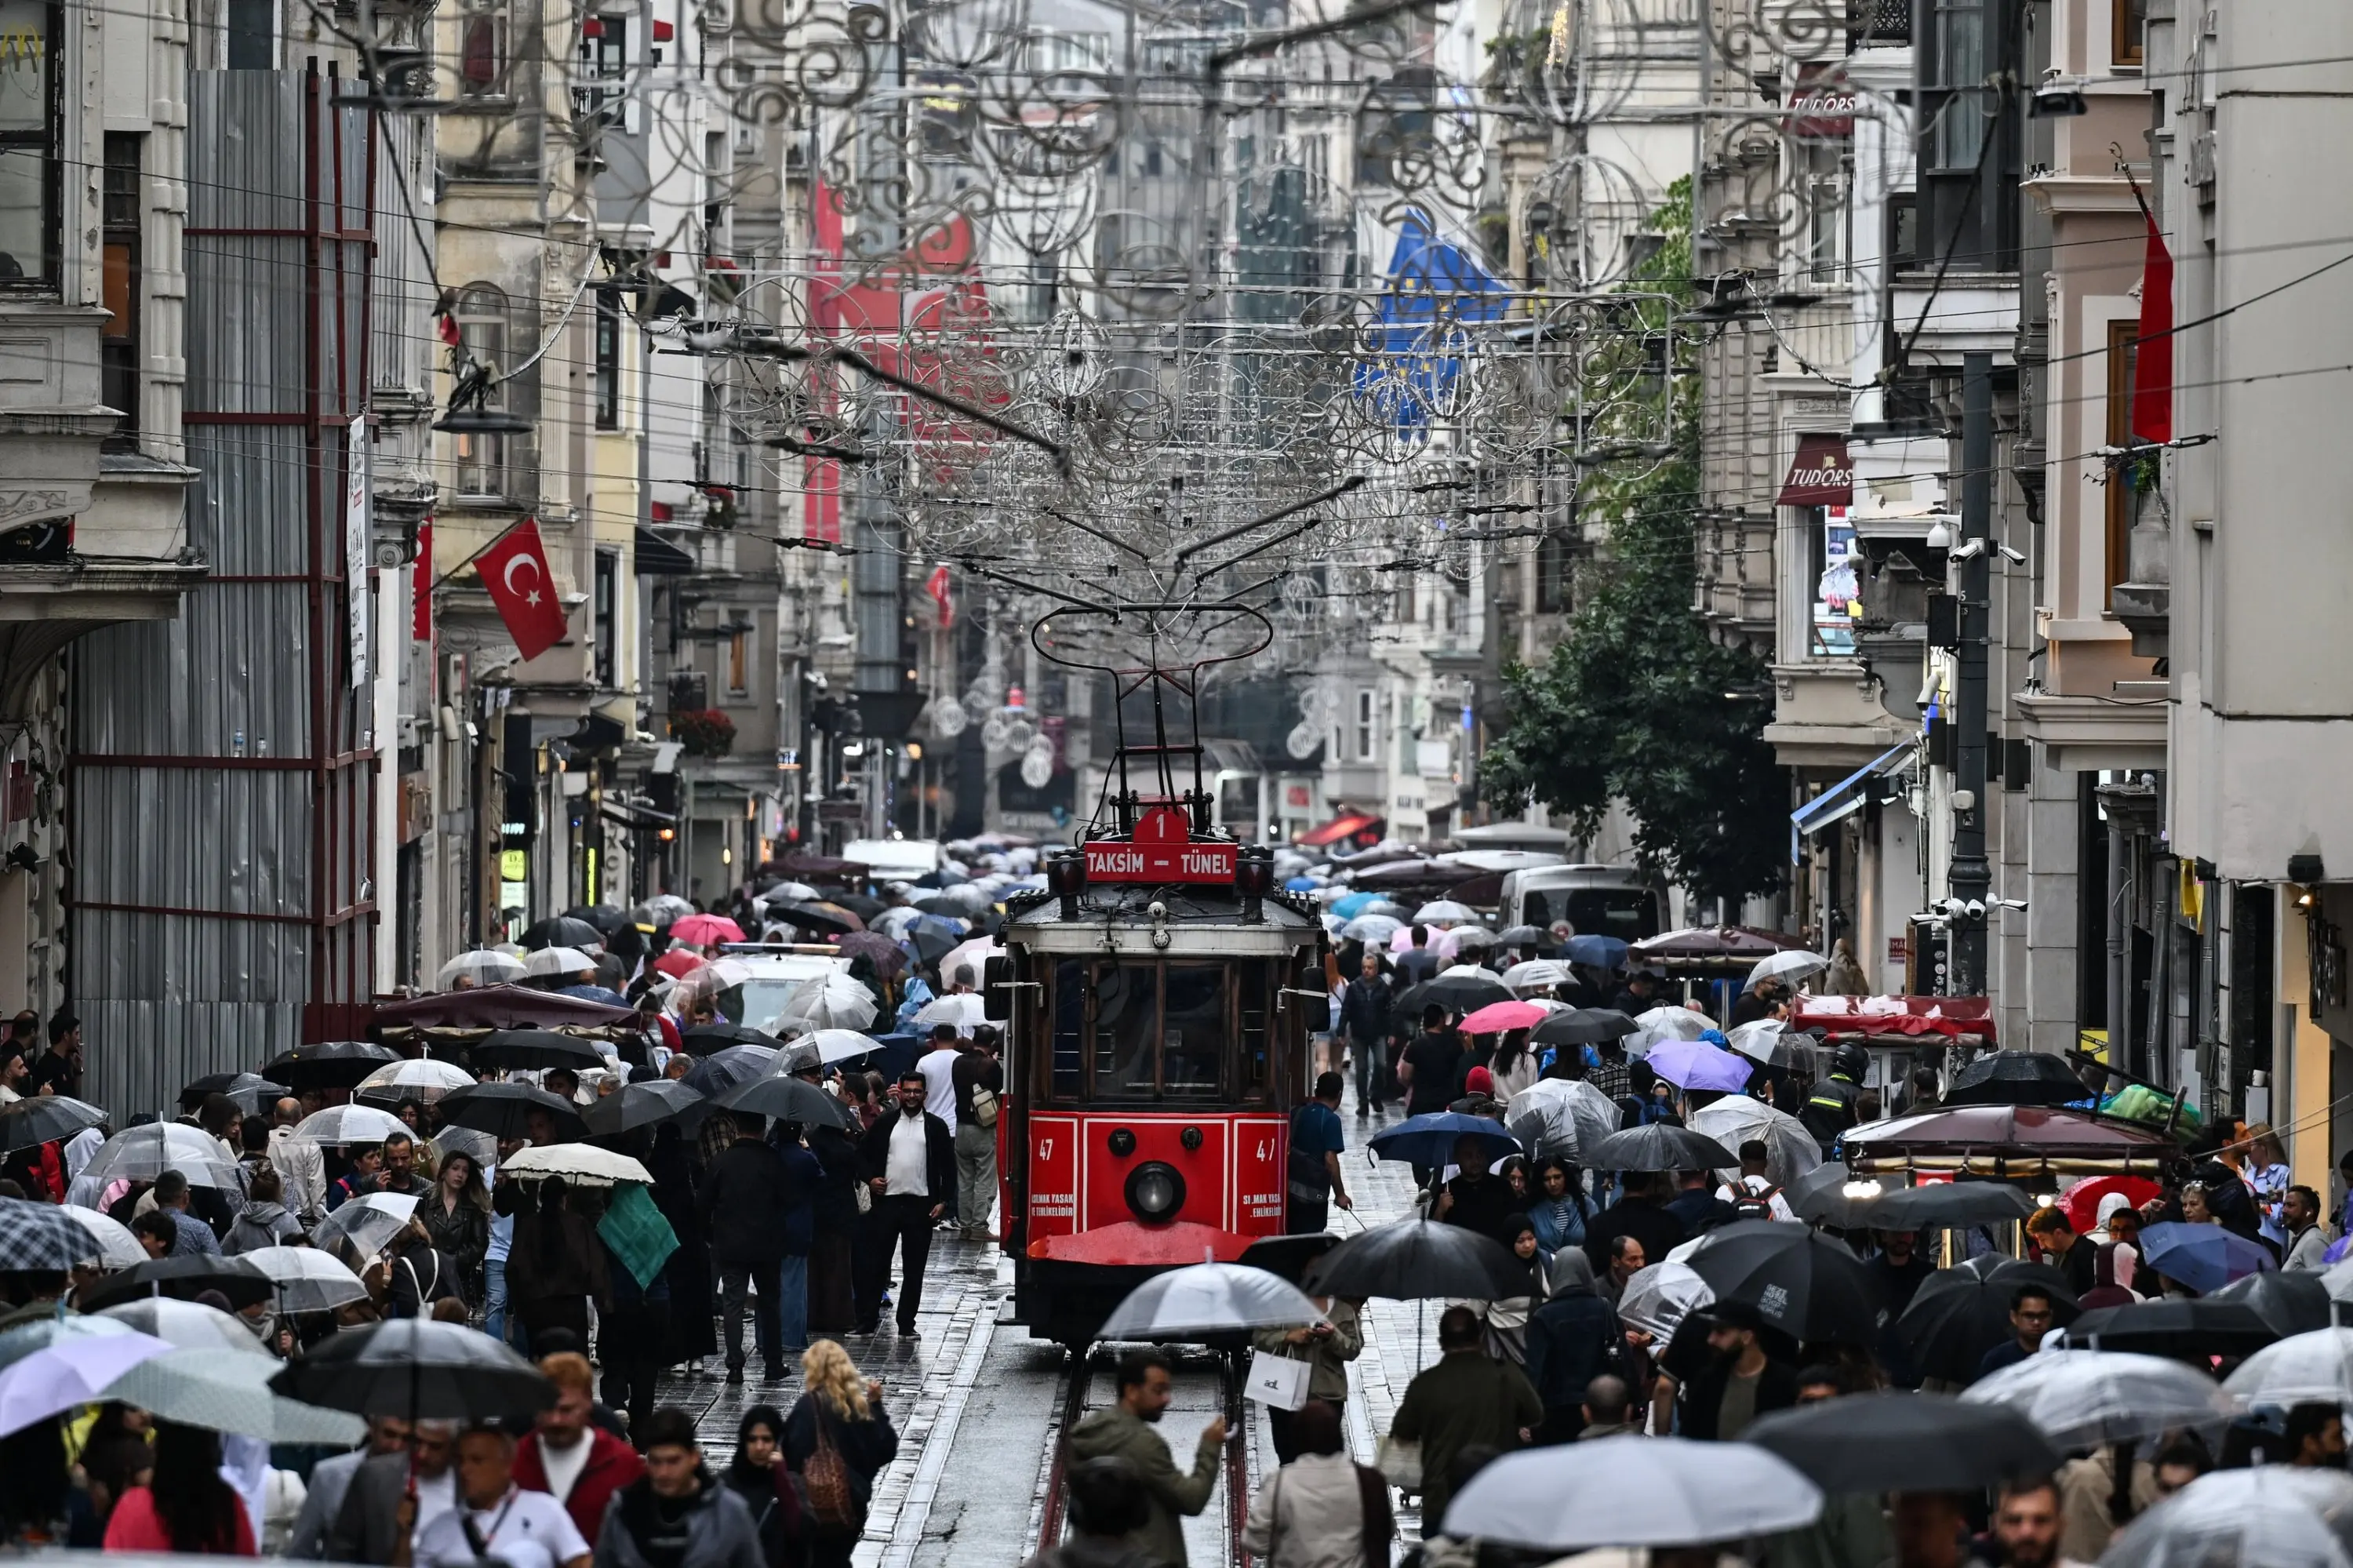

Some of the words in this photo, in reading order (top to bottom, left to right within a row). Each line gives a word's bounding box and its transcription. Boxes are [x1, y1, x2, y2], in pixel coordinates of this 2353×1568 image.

[1794, 96, 1856, 111] TUDORS
[1791, 468, 1853, 486] TUDORS
[1155, 813, 1165, 839] 1
[1087, 848, 1144, 872] TAKSİM
[1180, 849, 1231, 874] TÜNEL
[1038, 1138, 1053, 1161] 47
[1051, 1193, 1074, 1203] YASAK
